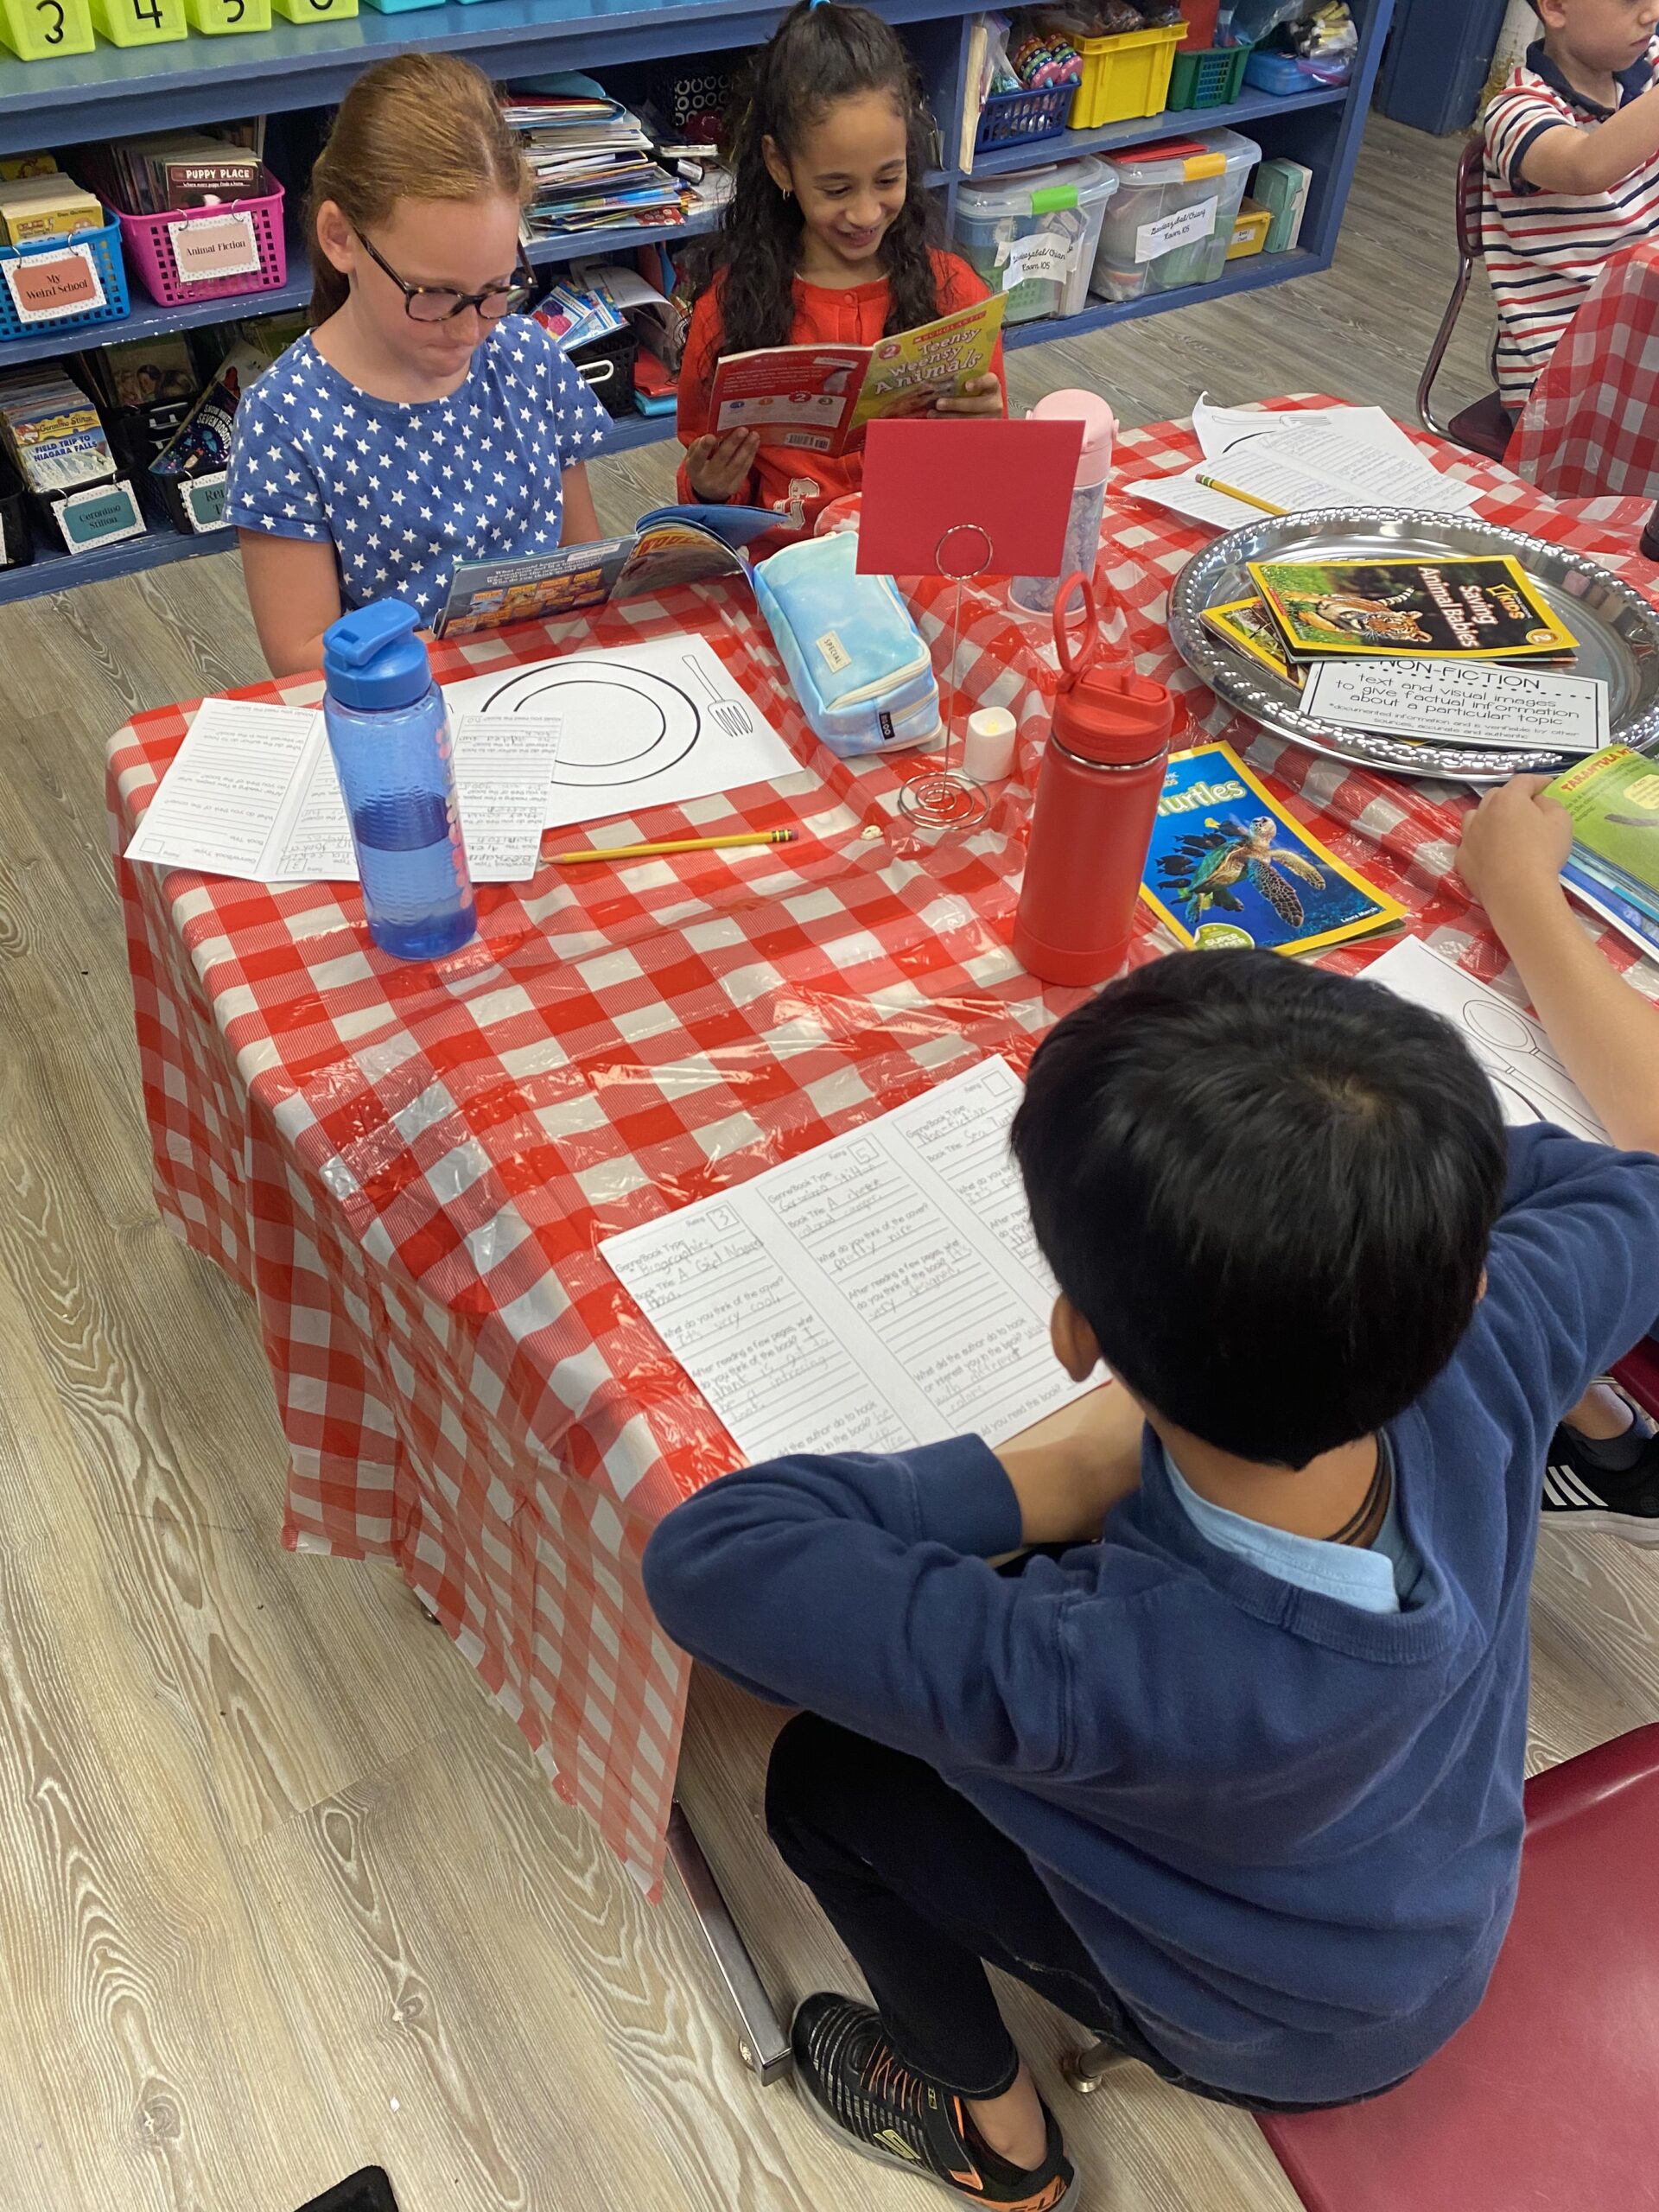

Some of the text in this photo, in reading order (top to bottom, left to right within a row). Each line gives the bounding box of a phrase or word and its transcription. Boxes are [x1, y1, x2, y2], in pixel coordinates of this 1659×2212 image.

[36, 0, 64, 44] 3
[134, 0, 163, 28] 4
[186, 169, 250, 179] PUPPY PLACE
[187, 239, 246, 257] Animal Fiction
[1022, 263, 1039, 271] Room
[26, 279, 88, 300] Weird School
[47, 274, 60, 284] My
[918, 327, 982, 355] Teensy
[883, 346, 897, 359] 2
[889, 346, 963, 377] Weensy
[874, 348, 983, 395] Animals
[793, 393, 805, 402] 2
[40, 416, 93, 432] Geronimo Stilton
[196, 413, 232, 449] SEVEN ROBOTS
[34, 442, 98, 462] NIAGARA FALLS
[35, 434, 91, 454] FIELD TRIP TO
[79, 503, 121, 523] Geronimo
[89, 515, 118, 530] Stilton
[1417, 566, 1481, 648] Animal Babies
[1459, 584, 1498, 626] Saving
[1497, 594, 1525, 620] KIDS
[1532, 634, 1553, 643] 2
[823, 638, 842, 664] SPECIAL
[1380, 660, 1540, 690] NON-FICTION
[1336, 680, 1580, 719] to give factual information
[1358, 672, 1557, 708] text and visual images
[1350, 692, 1400, 707] about
[1425, 704, 1510, 721] particular
[1517, 714, 1563, 725] topic
[1395, 713, 1449, 725] information
[1374, 718, 1412, 728] sources,
[1417, 724, 1460, 734] accurate
[1484, 730, 1528, 740] authentic
[1560, 753, 1622, 791] TARANTULA
[1340, 914, 1358, 923] Laura
[1205, 933, 1239, 946] SUPER
[926, 1147, 947, 1163] Book
[713, 1207, 729, 1226] 3
[787, 1216, 807, 1229] Book
[634, 1287, 655, 1301] Book
[849, 1286, 869, 1300] After
[871, 1269, 899, 1289] reading
[868, 1293, 884, 1306] you
[883, 1283, 902, 1296] think
[664, 1324, 683, 1338] What
[697, 1312, 714, 1325] you
[715, 1301, 733, 1315] think
[915, 1366, 934, 1382] What
[962, 1338, 985, 1356] author
